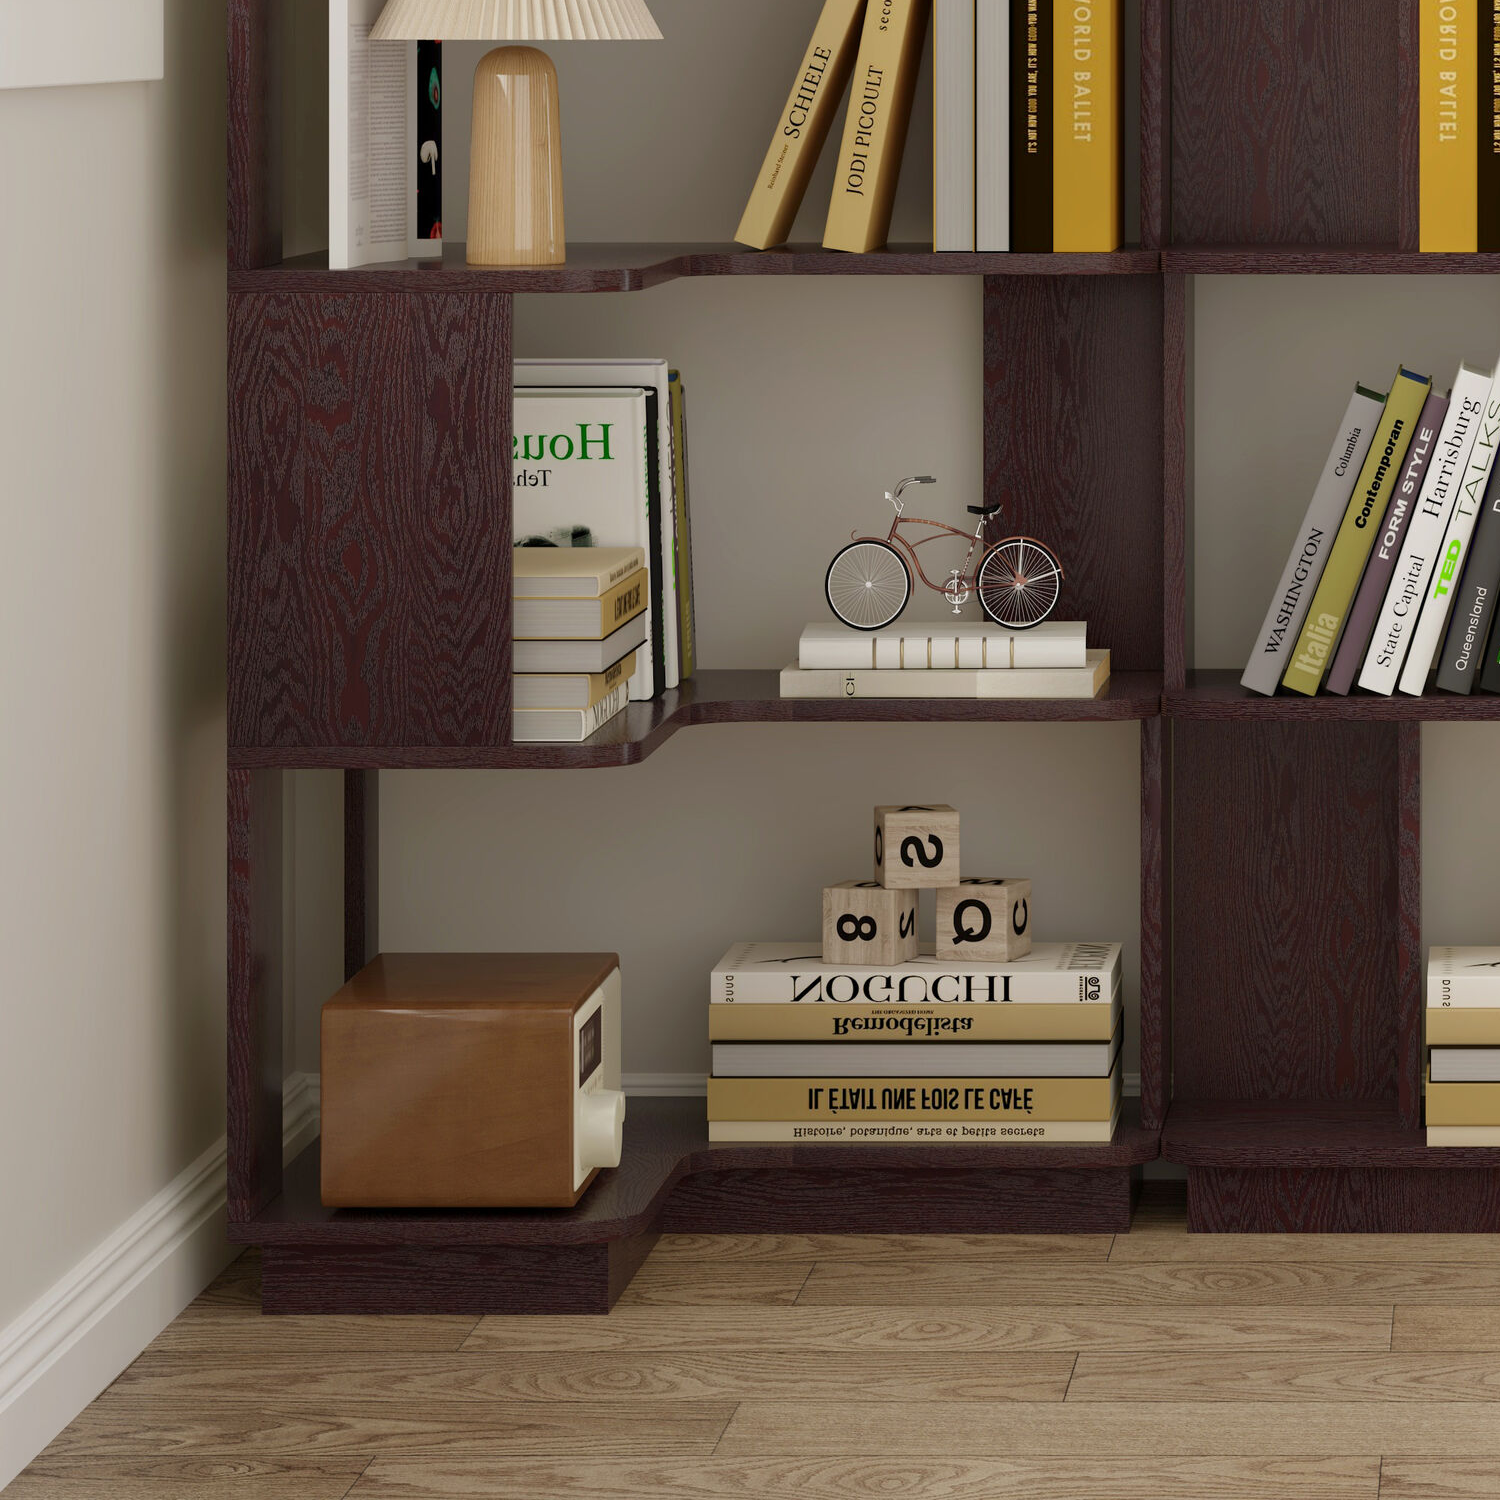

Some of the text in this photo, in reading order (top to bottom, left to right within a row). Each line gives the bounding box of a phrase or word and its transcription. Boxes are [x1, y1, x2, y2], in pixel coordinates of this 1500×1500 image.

[783, 45, 832, 139] SCHIELE
[846, 64, 884, 196] JODI PICOULT
[1073, 71, 1092, 143] BALLET
[1334, 426, 1362, 478] Columbia
[1354, 418, 1405, 530] Contemporan
[1378, 426, 1434, 561] FORM STYLE
[1422, 396, 1482, 519] Harrisburg
[1264, 527, 1325, 655] WASHINGTON
[1376, 554, 1425, 668] State Capital
[1433, 538, 1462, 600] TED
[1294, 612, 1340, 676] Italia
[1455, 586, 1488, 672] Queensland
